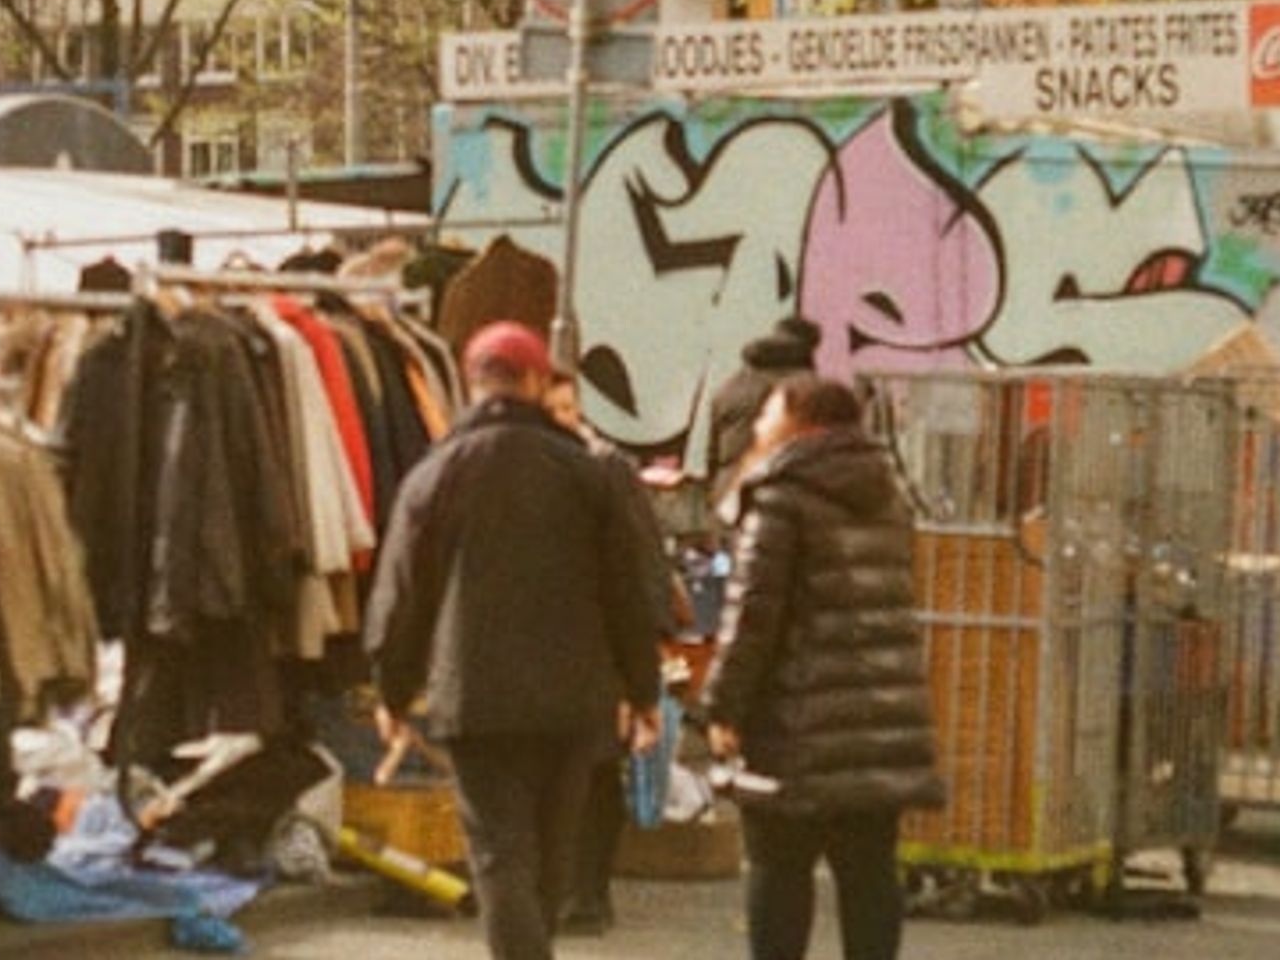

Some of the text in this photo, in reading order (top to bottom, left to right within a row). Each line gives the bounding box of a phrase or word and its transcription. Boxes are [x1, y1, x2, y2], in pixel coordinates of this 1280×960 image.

[654, 31, 764, 79] OODJES
[788, 24, 897, 72] GEKOELDE
[902, 19, 1050, 67] FRISDRANKEN
[1070, 13, 1157, 59] PATATES
[1166, 11, 1238, 56] FRITES
[1035, 63, 1180, 111] SNACKS
